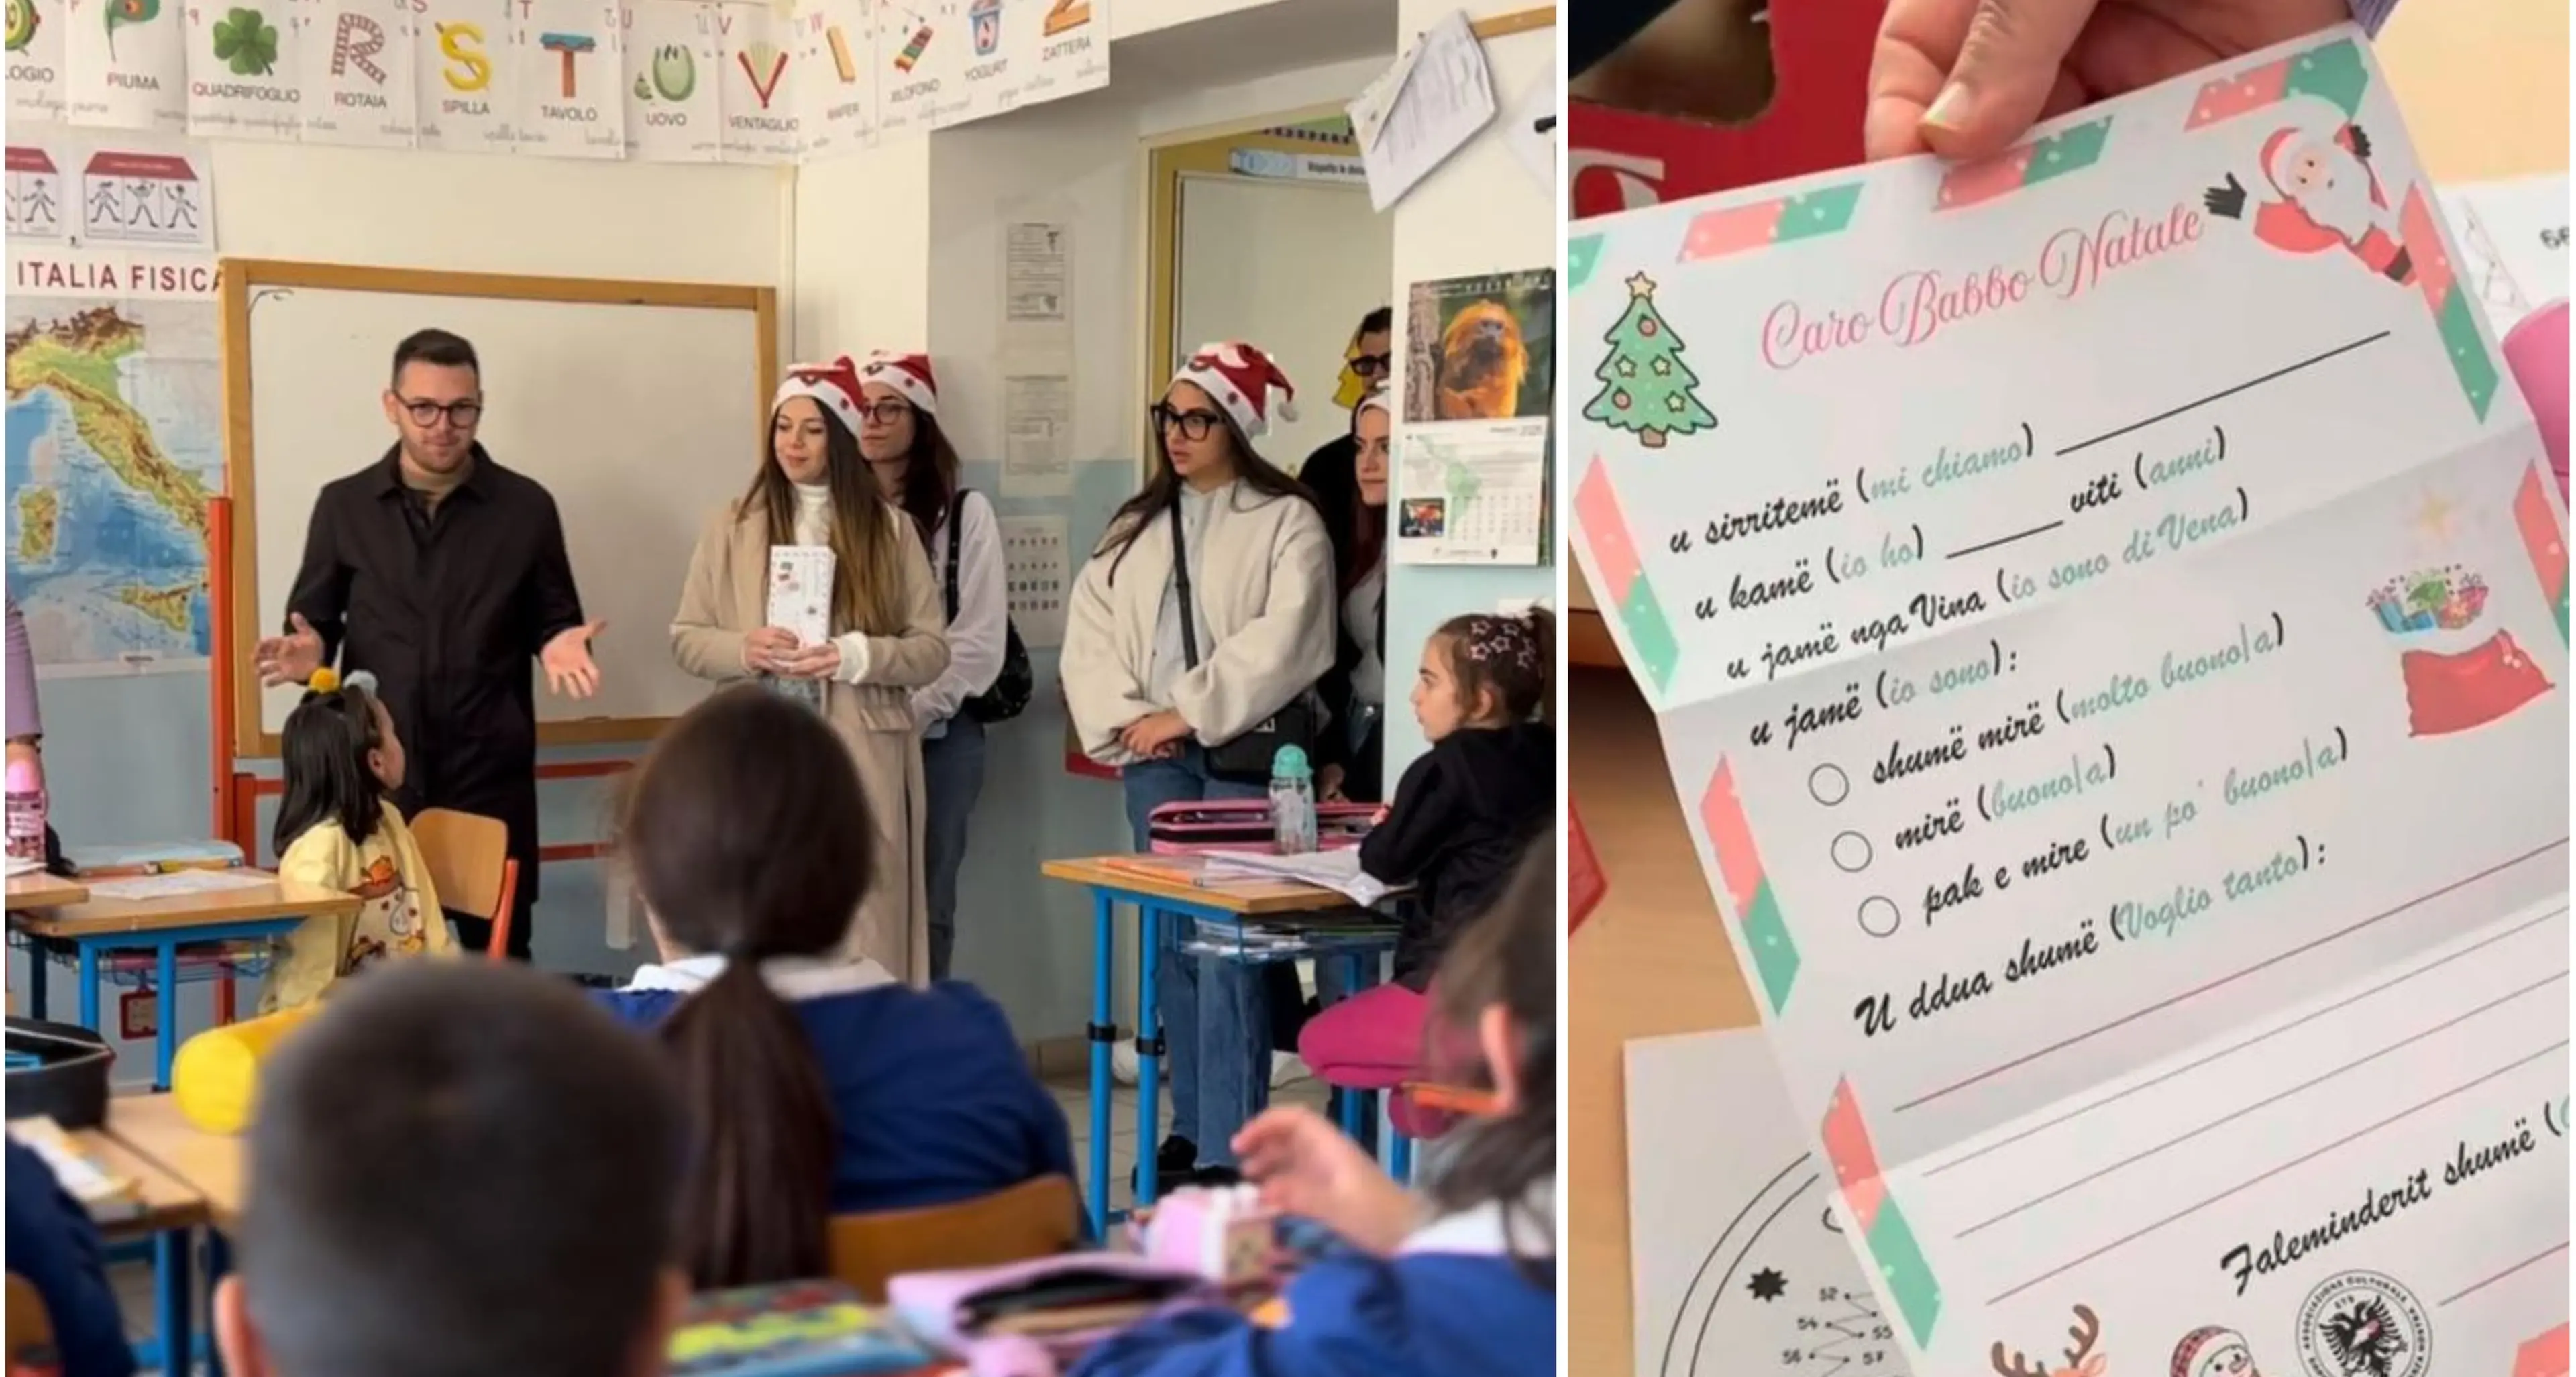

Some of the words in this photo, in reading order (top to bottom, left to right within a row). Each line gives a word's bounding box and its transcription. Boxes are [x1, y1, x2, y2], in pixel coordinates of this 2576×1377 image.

[1042, 37, 1091, 61] ZATTERA
[5, 66, 54, 83] OGIO
[107, 72, 160, 90] PIUMA
[192, 82, 301, 103] QUADRIFOGLIO
[334, 92, 387, 108] ROTAIA
[890, 78, 941, 103] XILOFONO
[442, 100, 490, 115] SPILLA
[541, 105, 598, 122] TAVOLO
[646, 113, 687, 126] UOVO
[729, 116, 799, 131] VENTAGLIO
[18, 261, 118, 290] ITALIA
[1762, 300, 1875, 370] Caro
[1878, 265, 2035, 347] Babbo
[2039, 203, 2206, 299] Natale
[1705, 479, 1843, 545] sirritemë
[1856, 467, 1911, 503] (mi
[1922, 422, 2033, 488] chiamo)
[1729, 559, 1814, 609] kamë
[1825, 547, 1868, 583] (io
[1881, 524, 1924, 564] ho)
[2070, 473, 2122, 513] viti
[2134, 425, 2226, 489] (anni)
[1761, 622, 1839, 680] jamë
[1851, 615, 1908, 650] nga
[1908, 591, 1986, 628] Vina
[1996, 568, 2037, 604] (io
[2048, 553, 2110, 590] sono
[2123, 529, 2155, 565] di
[2156, 487, 2248, 551] Vena)
[1784, 683, 1862, 750] jamë
[1876, 669, 1916, 709] (io
[1929, 639, 2017, 694] sono):
[1872, 725, 1967, 785] shumë
[1978, 701, 2045, 751] mirë
[2056, 674, 2149, 724] (molto
[1895, 798, 1965, 850] mirë
[1923, 863, 1984, 926] pak
[1995, 868, 2011, 889] e
[2023, 838, 2089, 877] mire
[2100, 814, 2152, 848] (un
[1854, 993, 1897, 1037] U
[1909, 971, 1994, 1020] ddua
[2005, 919, 2099, 983] shumë
[2109, 882, 2212, 942] (Voglio
[2224, 835, 2326, 902] tanto):
[2220, 1168, 2432, 1297] Faleminderit
[2443, 1118, 2536, 1186] shumë
[1820, 1287, 1839, 1301] 52
